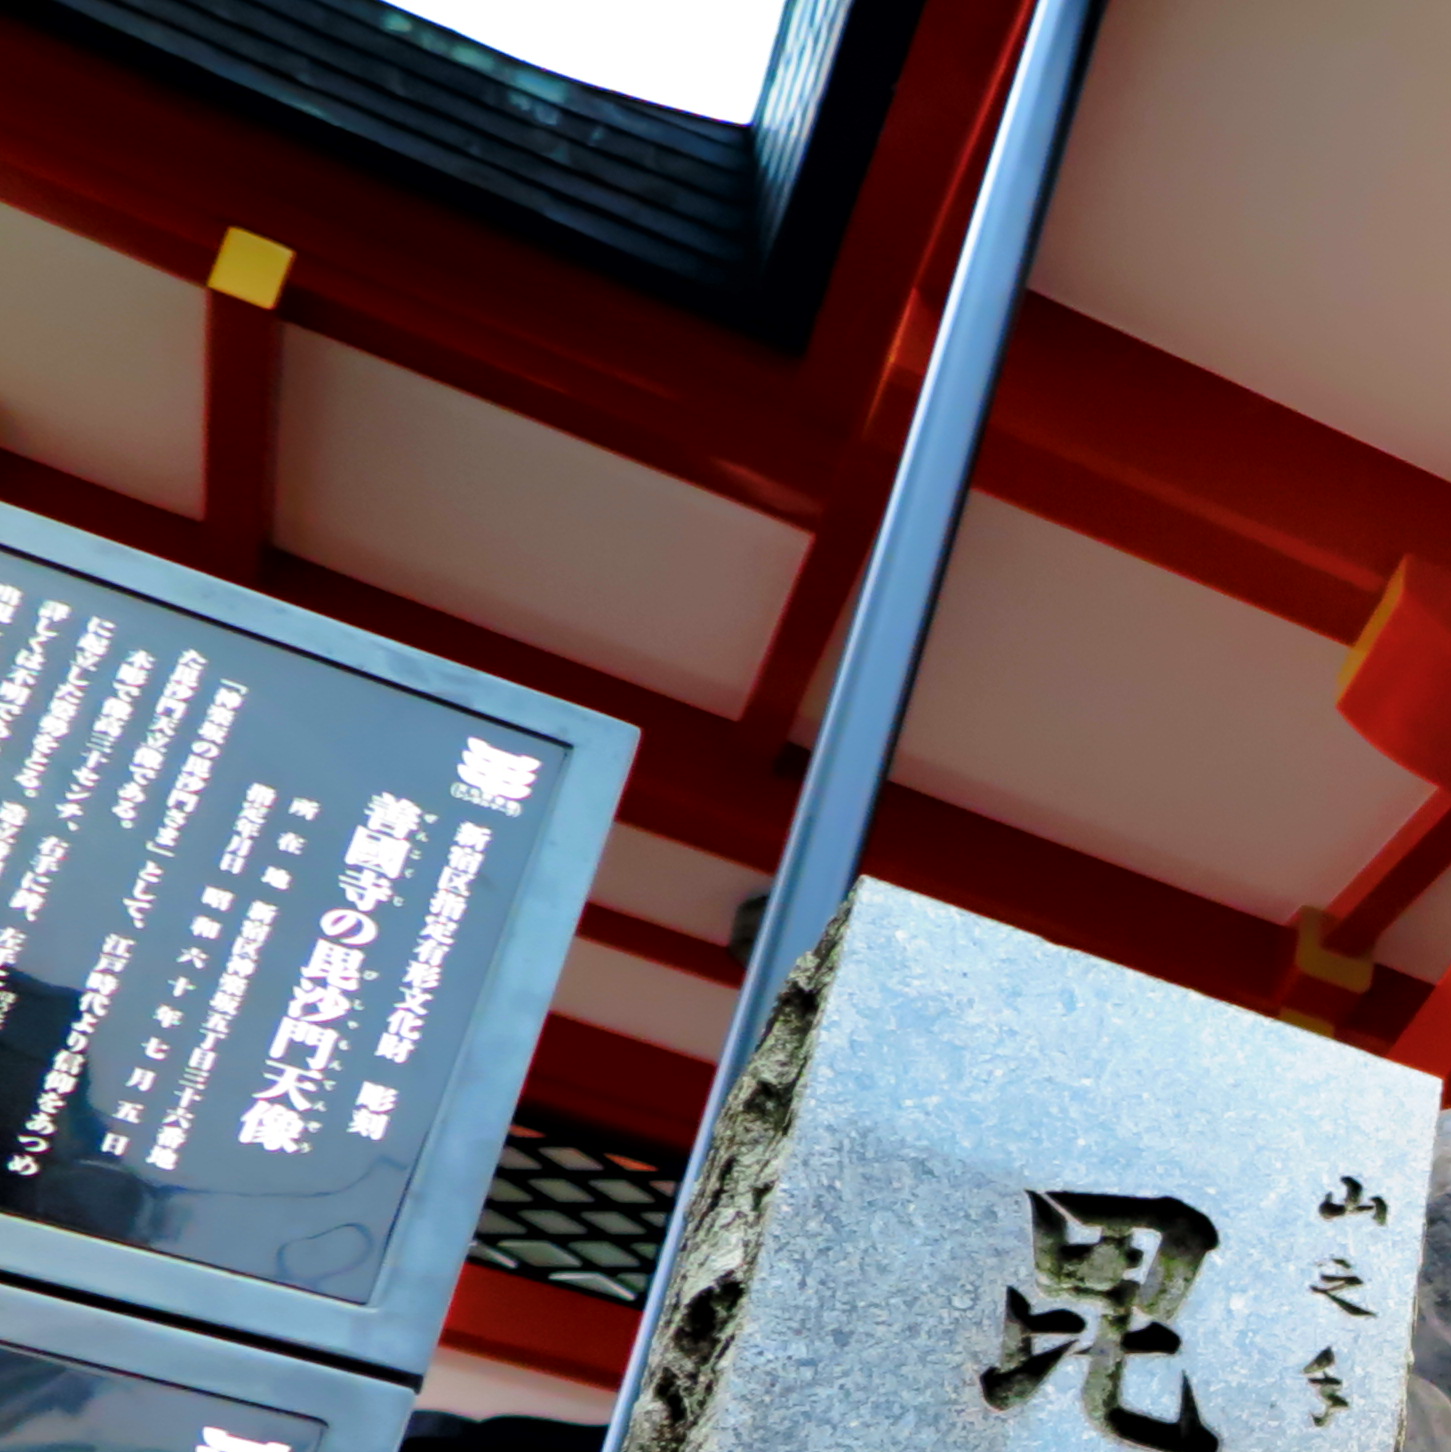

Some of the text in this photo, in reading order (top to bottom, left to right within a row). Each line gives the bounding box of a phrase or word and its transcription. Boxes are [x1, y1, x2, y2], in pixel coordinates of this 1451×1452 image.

[238, 791, 424, 1155] 善國寺の毘沙門天像
[374, 820, 493, 1064] 新宿区指定有形文化財
